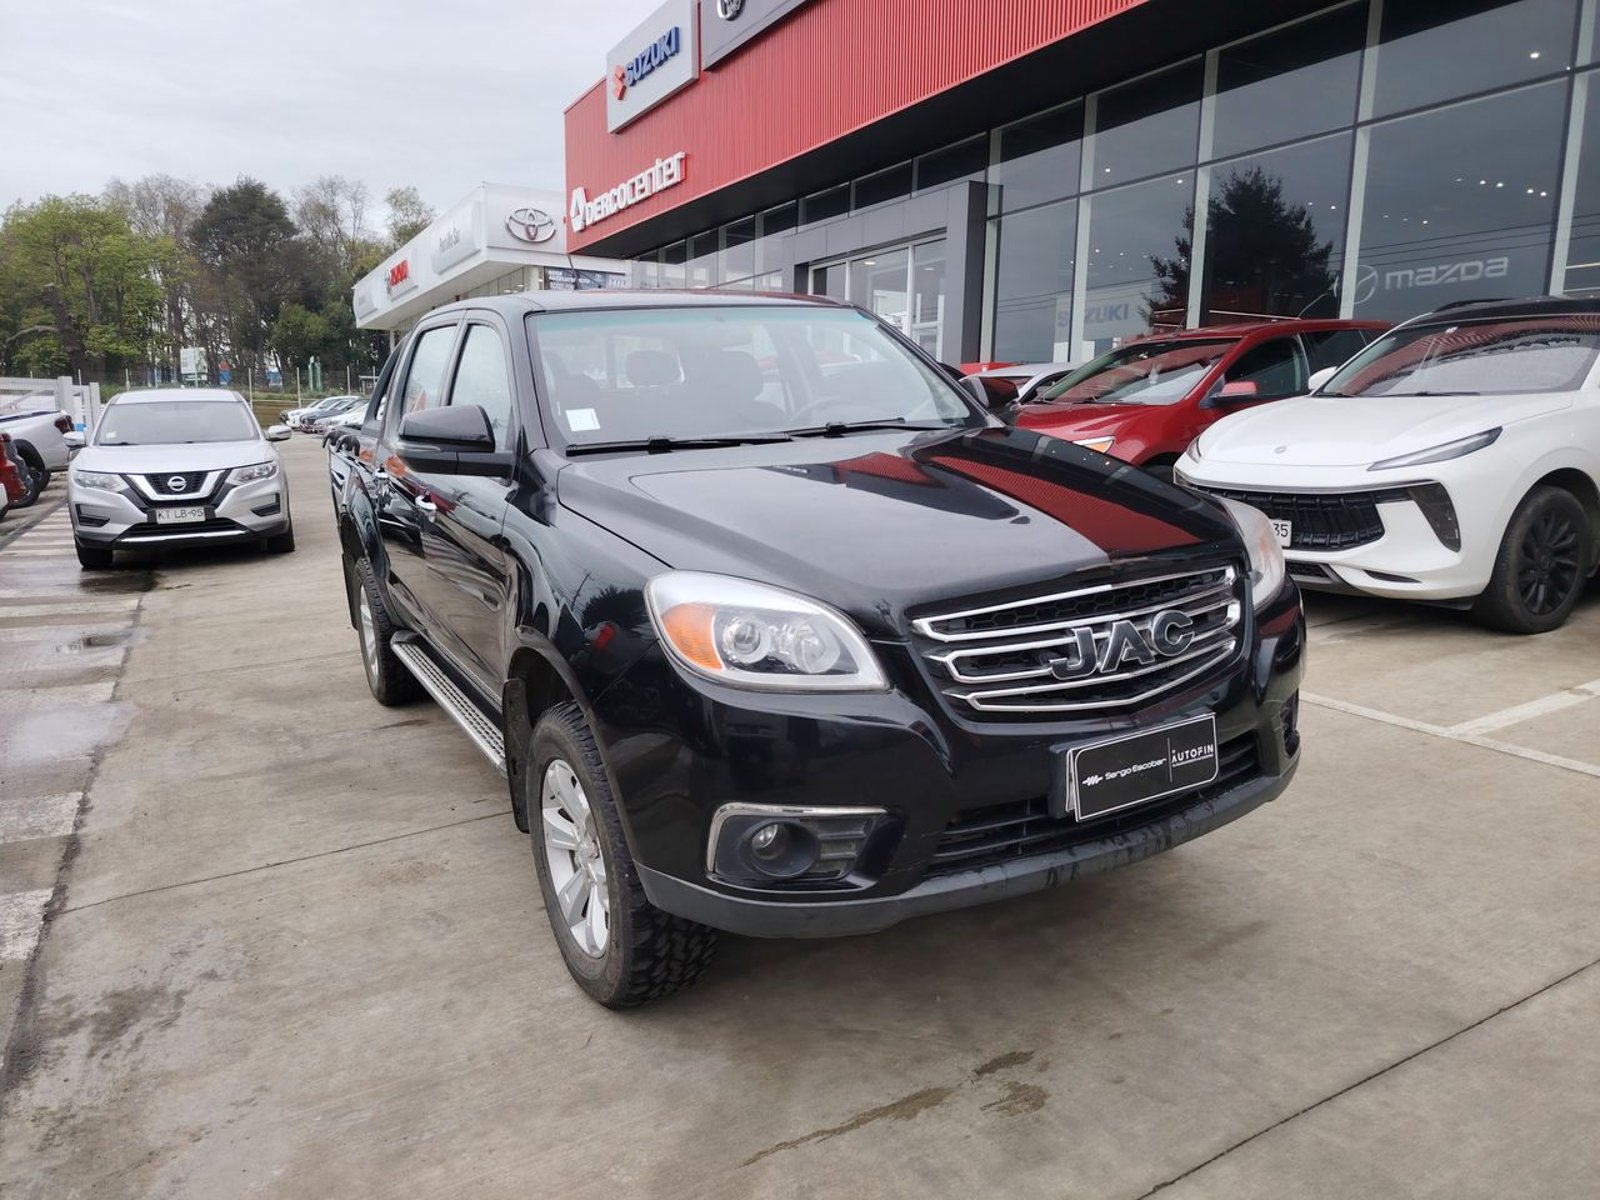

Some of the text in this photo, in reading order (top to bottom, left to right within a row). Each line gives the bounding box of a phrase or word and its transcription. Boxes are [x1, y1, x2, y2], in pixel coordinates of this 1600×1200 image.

[625, 25, 680, 87] SUZUKI
[1057, 303, 1129, 327] SZUKI
[1048, 608, 1196, 681] JAC
